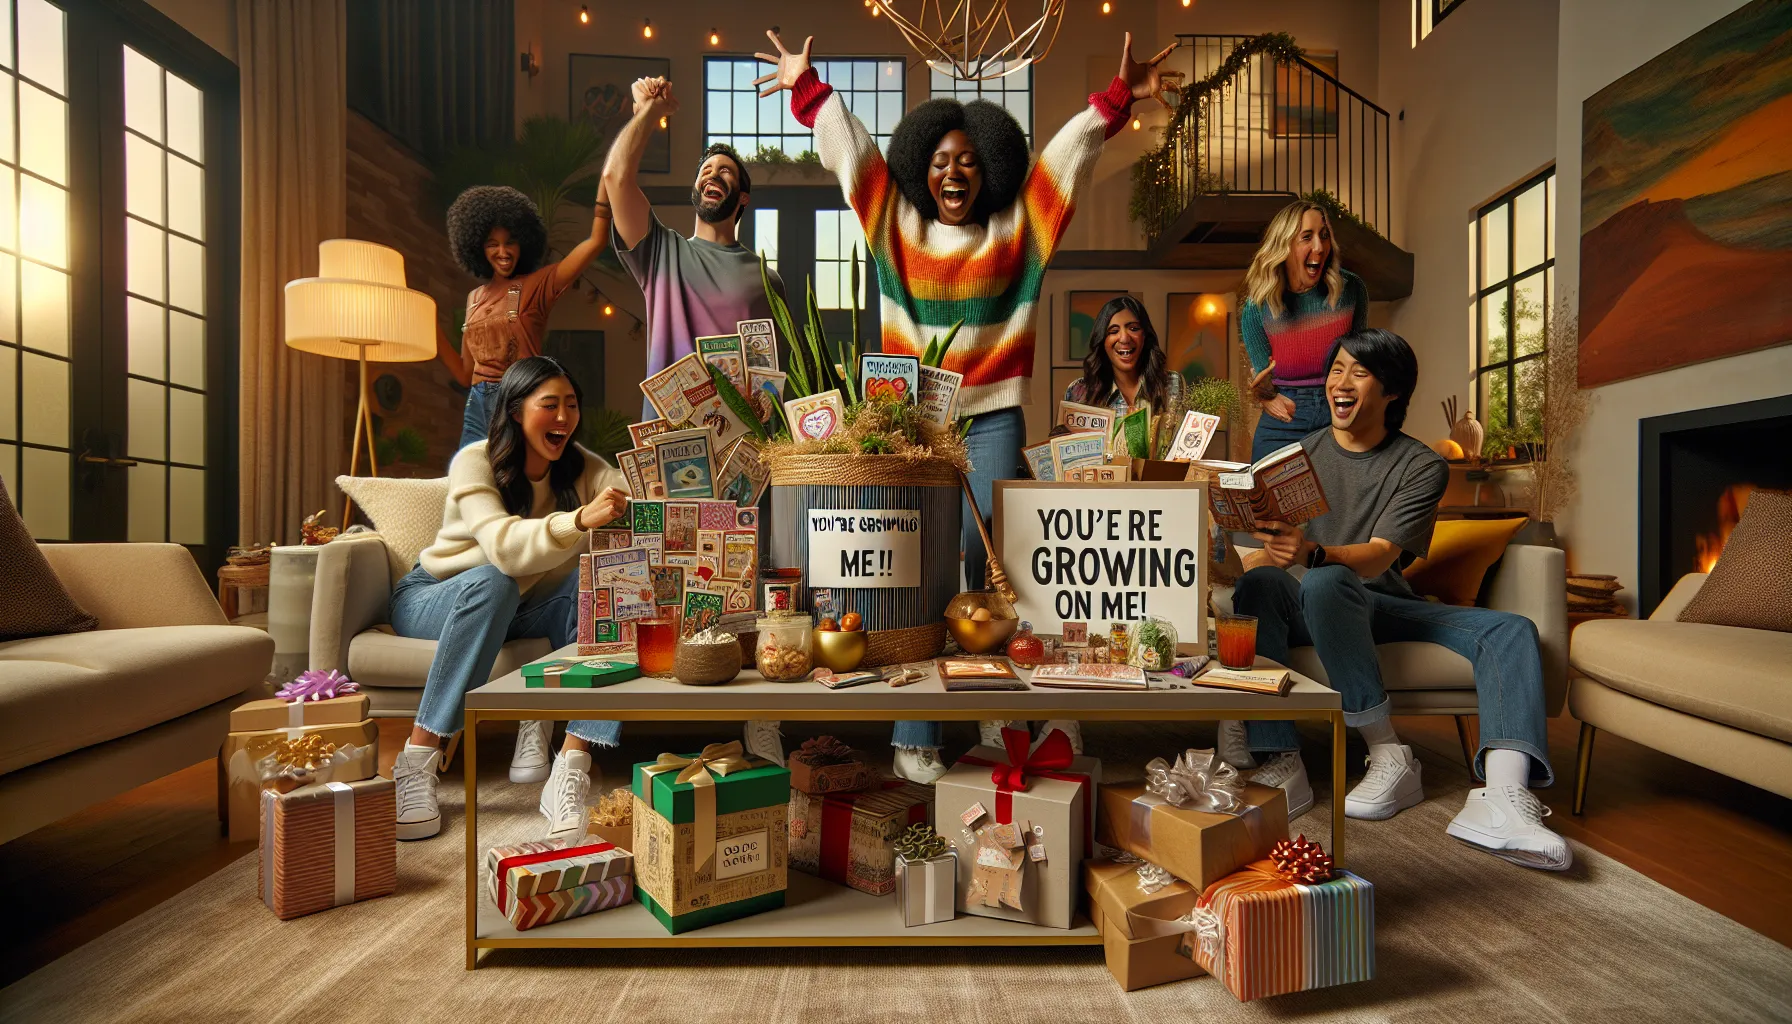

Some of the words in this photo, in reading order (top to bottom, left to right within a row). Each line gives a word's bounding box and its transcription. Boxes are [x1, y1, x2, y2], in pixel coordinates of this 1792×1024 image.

[840, 549, 893, 577] ME!!
[1031, 546, 1196, 588] GROWING
[1055, 590, 1092, 620] ON
[1101, 591, 1147, 621] ME!
